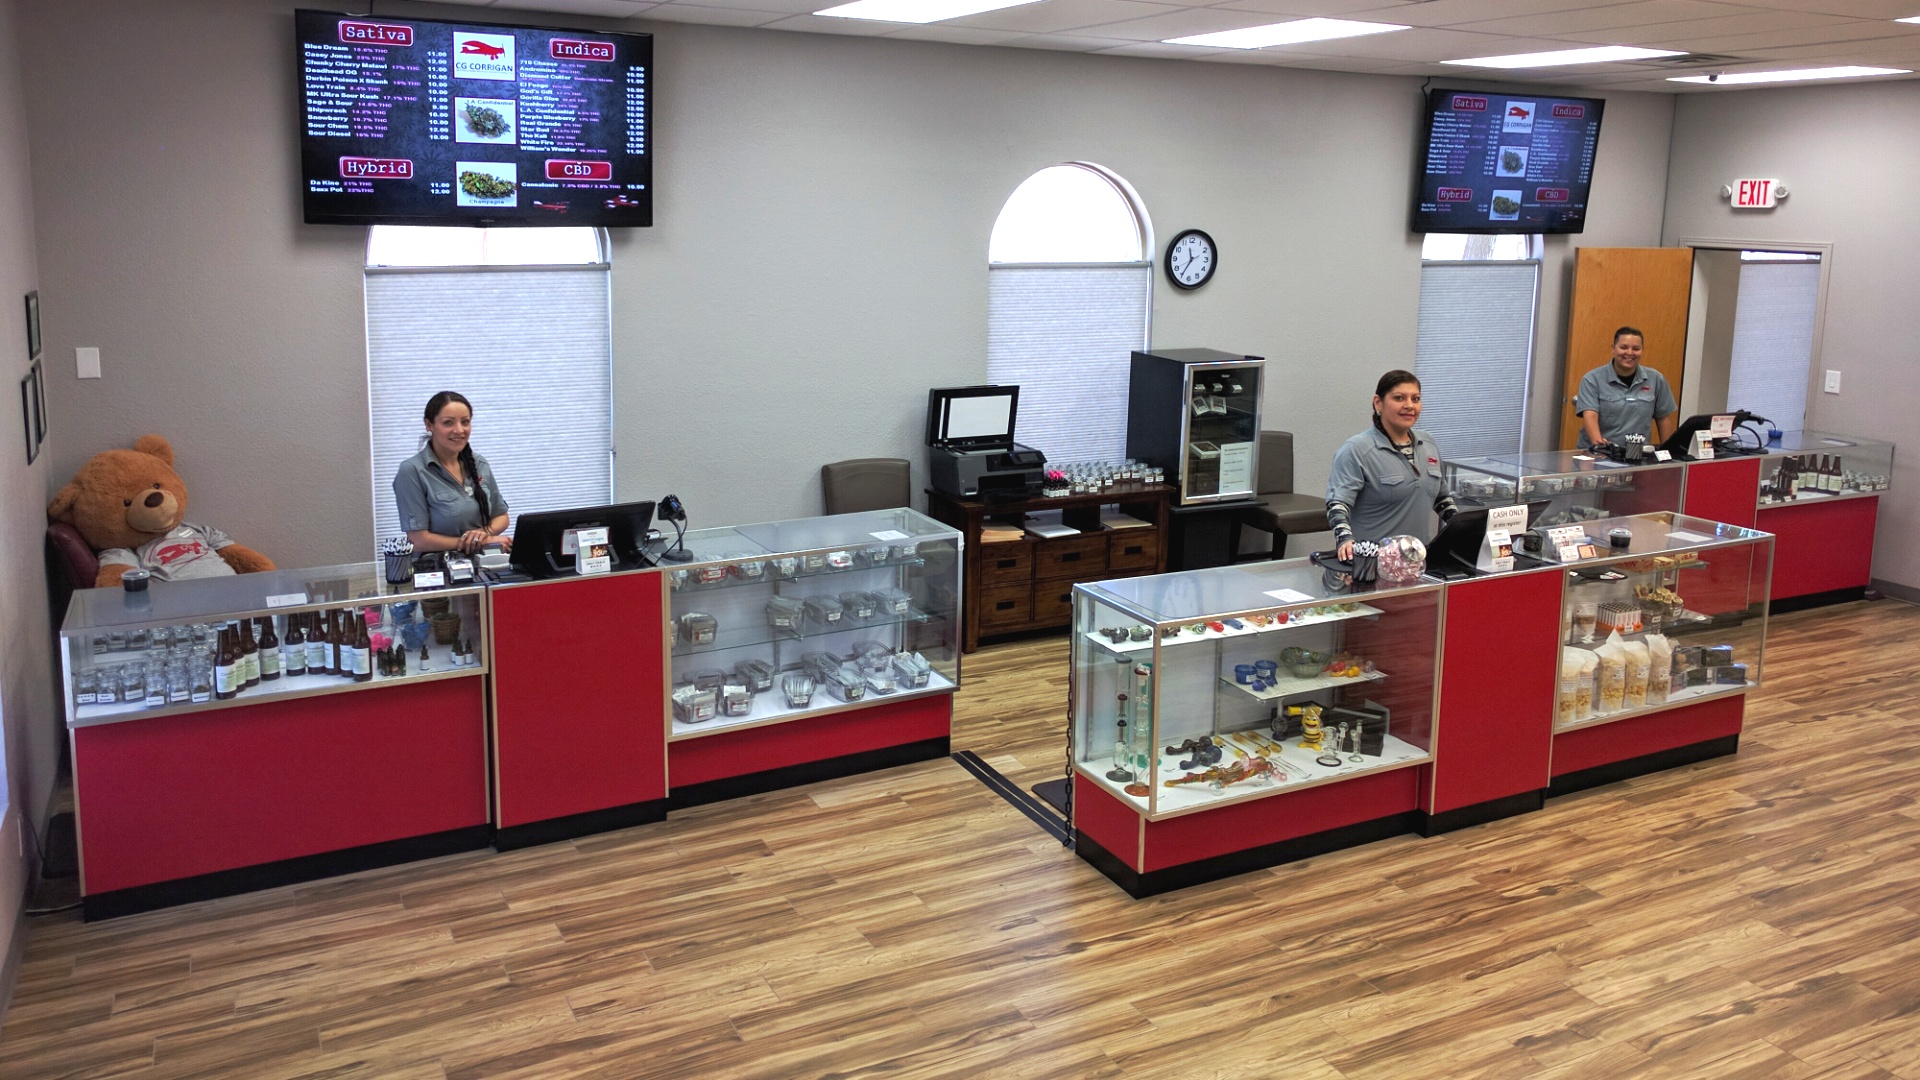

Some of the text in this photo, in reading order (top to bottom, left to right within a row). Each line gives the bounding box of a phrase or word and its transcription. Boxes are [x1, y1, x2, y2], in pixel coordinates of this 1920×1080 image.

[346, 26, 407, 41] Sativa
[556, 43, 609, 57] Indica
[470, 63, 512, 71] CORRIGAN
[1455, 99, 1484, 109] Sativa
[1555, 108, 1582, 116] Indica
[347, 161, 408, 176] Hybrid
[564, 165, 592, 176] CBD
[1440, 190, 1470, 200] Hybrid
[1738, 181, 1771, 205] EXIT
[1509, 509, 1524, 517] ONLY
